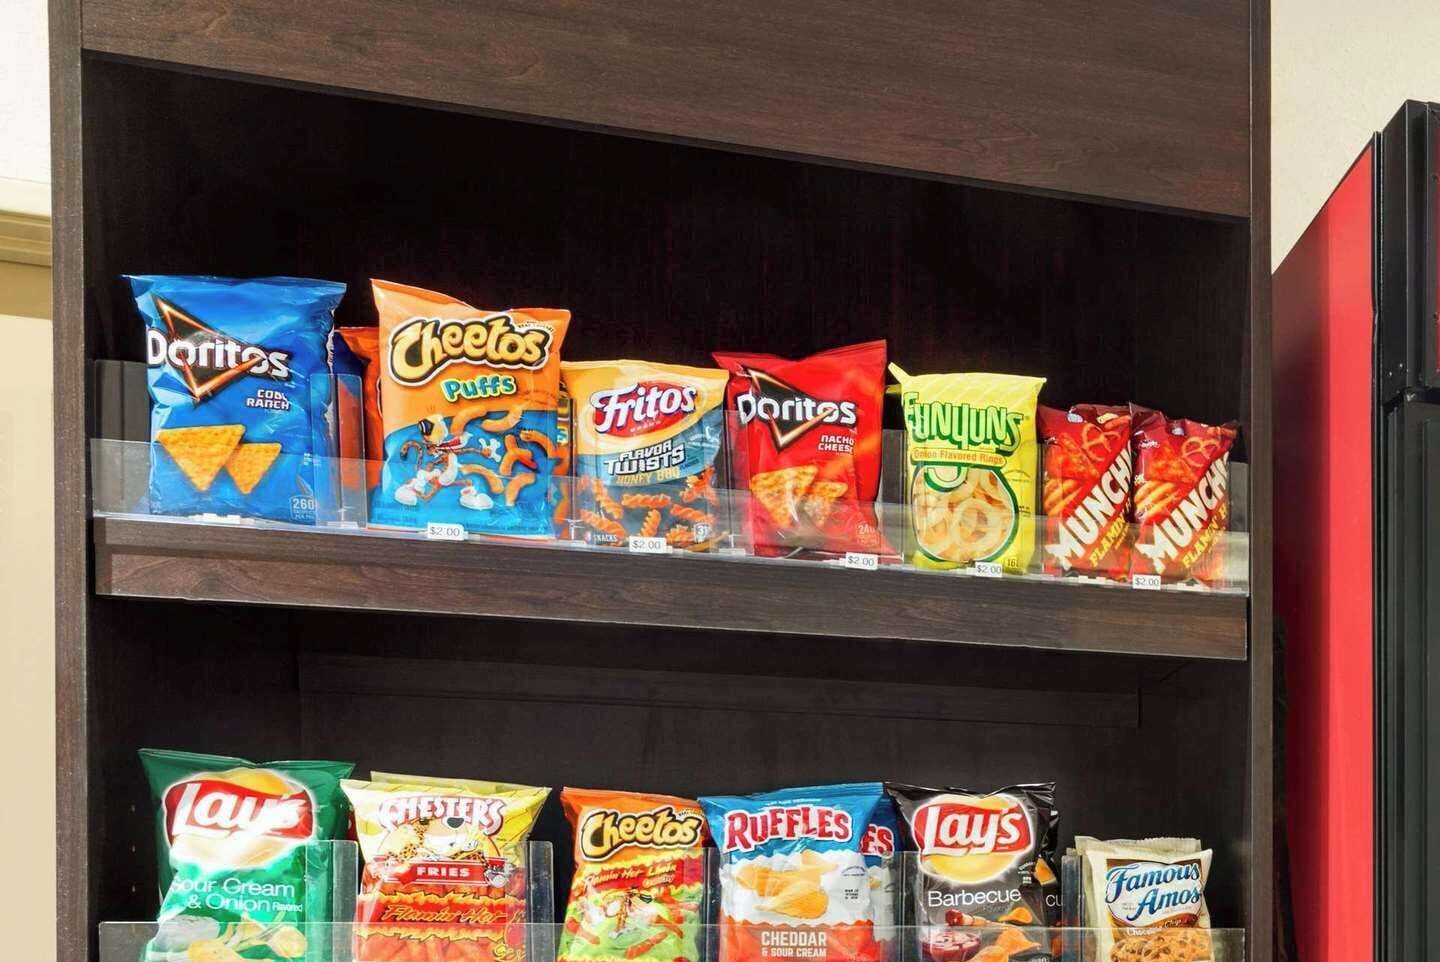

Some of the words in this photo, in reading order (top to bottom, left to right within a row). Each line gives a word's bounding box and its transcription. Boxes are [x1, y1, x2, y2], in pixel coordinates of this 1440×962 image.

[148, 329, 290, 378] Doritos
[391, 317, 552, 384] Cheetos
[257, 389, 288, 400] COOL
[441, 375, 517, 401] Puffs
[246, 398, 290, 410] RANCH
[591, 384, 698, 433] Fritos
[737, 393, 857, 425] Doritos
[619, 440, 673, 462] FLAVOR
[820, 435, 854, 445] NACHO
[604, 450, 686, 477] TWISTS
[1045, 440, 1132, 571] MUNCH
[1135, 452, 1229, 575] MUNCH
[430, 526, 461, 537] $2.00
[632, 540, 661, 550] $2.00
[848, 556, 875, 567] $2.00
[976, 565, 1001, 575] $2.00
[1135, 577, 1160, 587] $2.00
[172, 782, 306, 840] Lay's
[581, 806, 703, 860] Cheetos
[726, 806, 851, 852] RUFFLES
[922, 805, 1023, 856] Lay's
[416, 867, 470, 877] FRIES
[1105, 862, 1200, 904] Famous
[171, 878, 217, 893] Sour
[223, 878, 296, 897] Cream
[928, 887, 1022, 907] Barbecue
[187, 895, 201, 909] &
[205, 893, 271, 912] Onion
[1126, 886, 1202, 922] Amos
[761, 931, 828, 946] CHEDDAR
[771, 948, 794, 957] SOUR
[796, 948, 827, 957] CREAM
